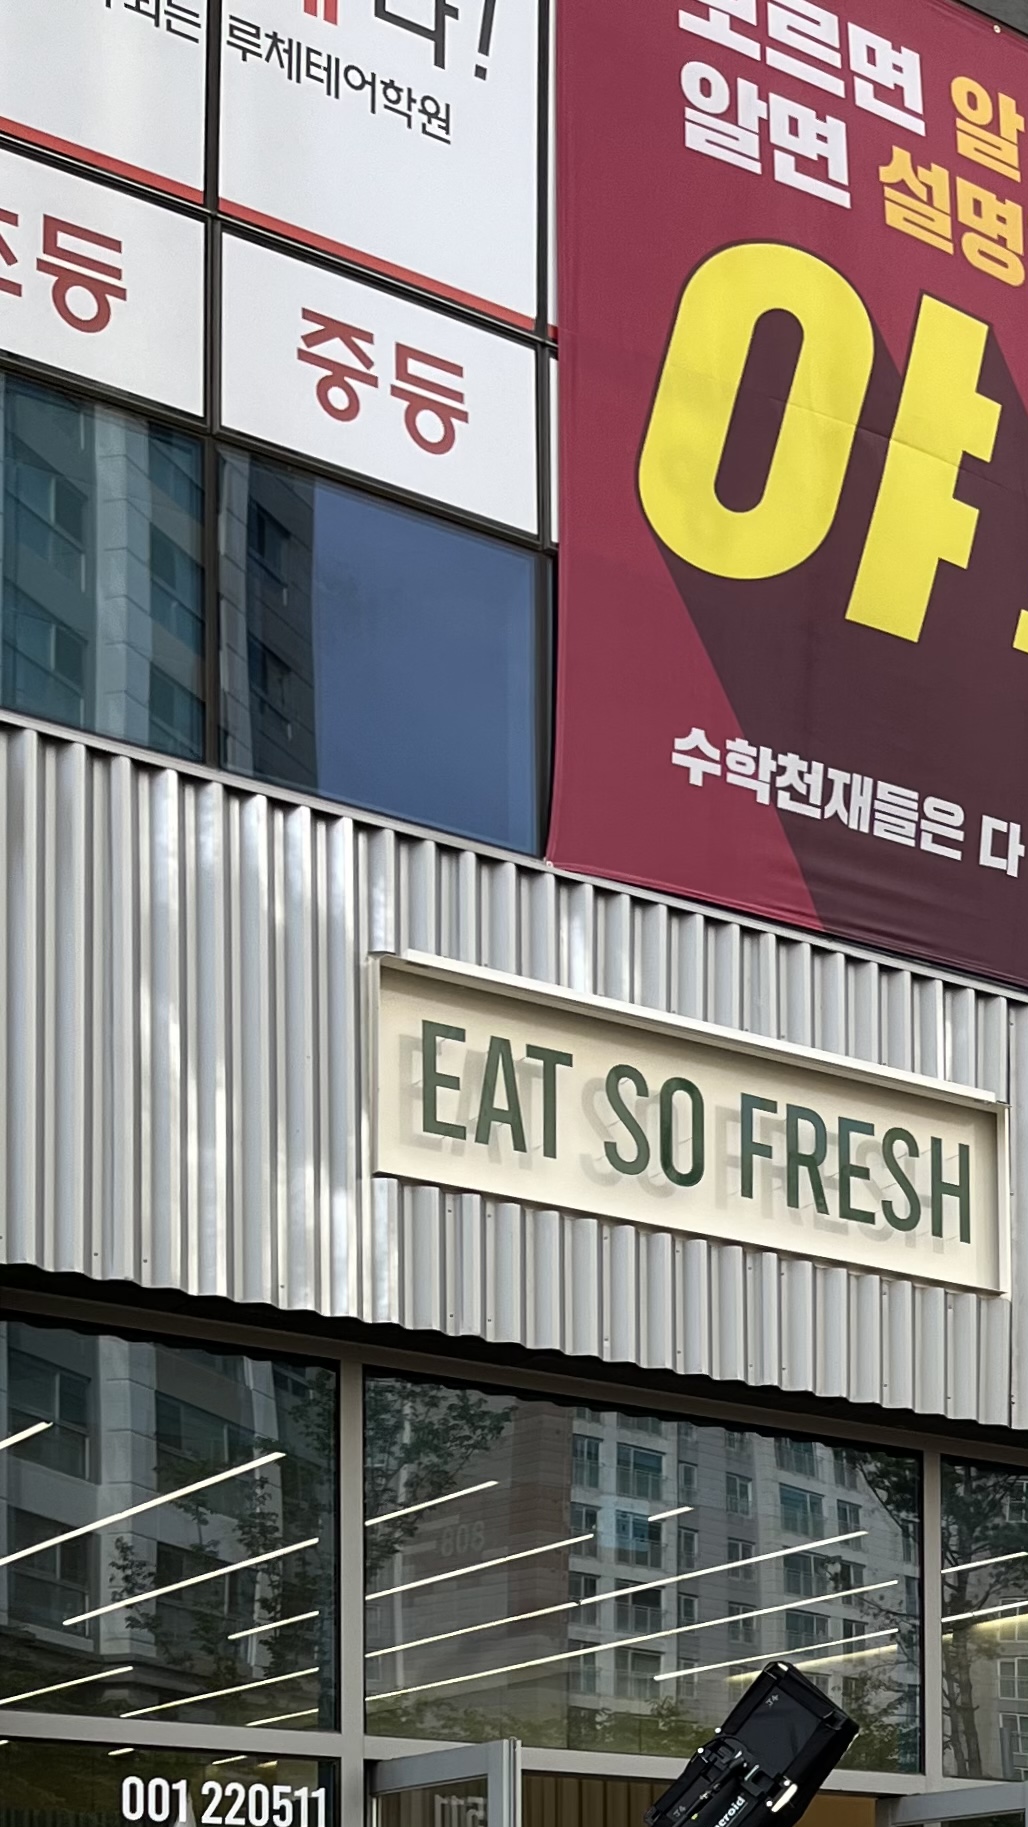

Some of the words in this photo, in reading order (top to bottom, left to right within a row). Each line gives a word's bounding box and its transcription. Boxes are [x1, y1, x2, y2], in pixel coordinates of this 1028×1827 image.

[226, 15, 452, 145] 루체테어학원
[680, 60, 852, 210] 알면
[950, 76, 1025, 183] 알
[297, 307, 470, 455] 중등
[638, 242, 1003, 643] 야
[670, 726, 966, 861] 수학천재들은
[979, 815, 1026, 878] 다
[421, 1019, 574, 1160] EAT
[603, 1063, 706, 1188] SO
[739, 1091, 973, 1246] FRESH
[121, 1775, 188, 1823] 001
